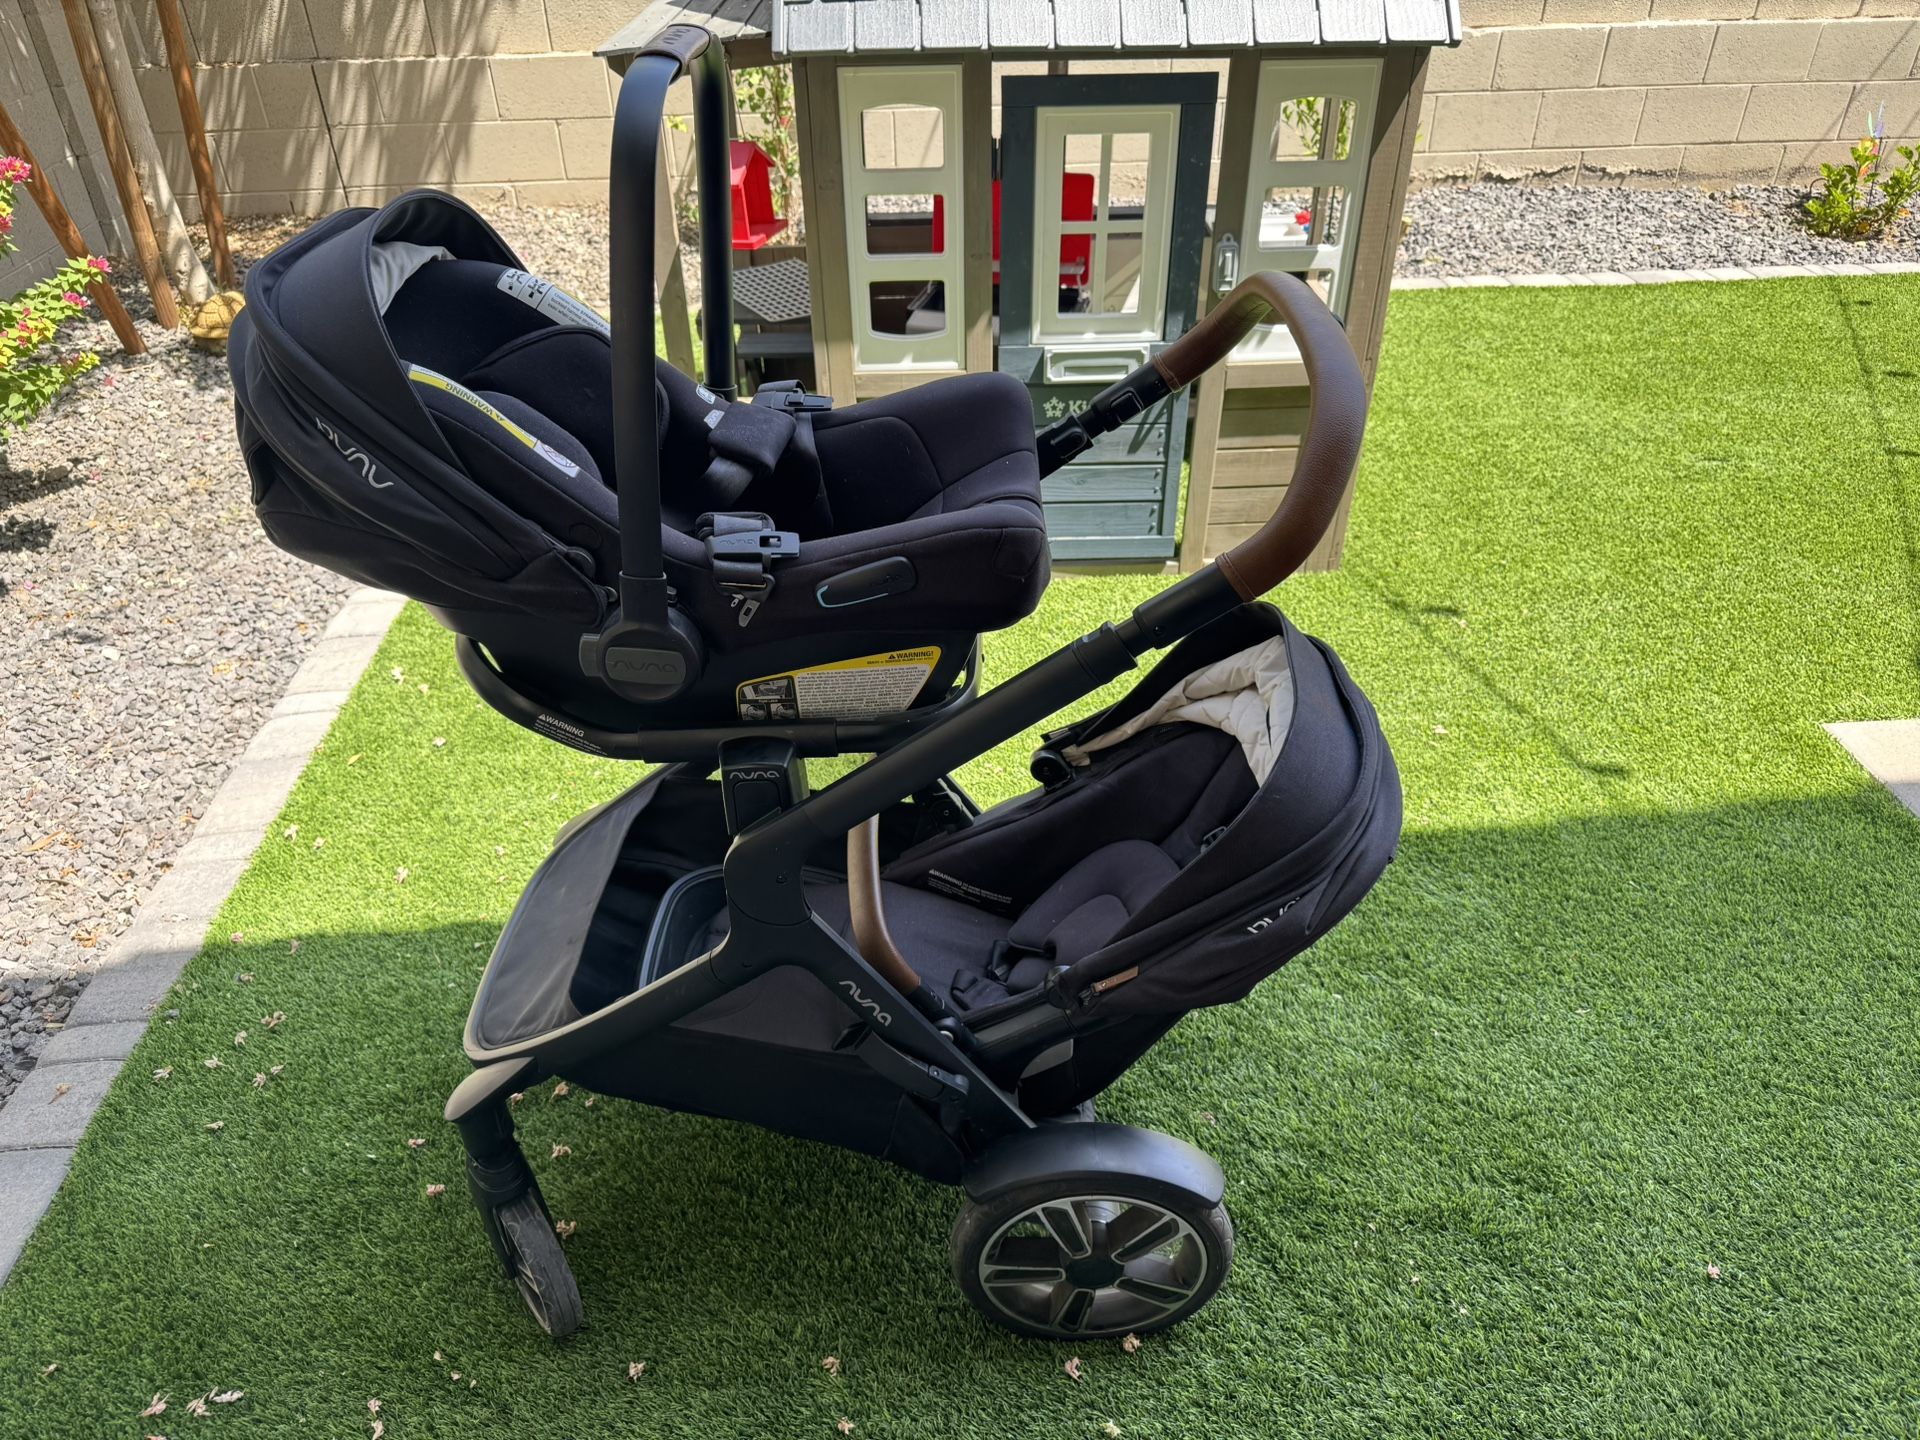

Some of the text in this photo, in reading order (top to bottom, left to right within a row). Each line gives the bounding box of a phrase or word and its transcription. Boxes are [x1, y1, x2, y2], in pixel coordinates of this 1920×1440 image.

[445, 382, 496, 416] WARNING
[896, 650, 934, 660] WARNING!
[545, 715, 585, 737] WARNING
[729, 770, 781, 780] nuna
[933, 869, 962, 886] WARNING
[839, 980, 892, 1027] nuna
